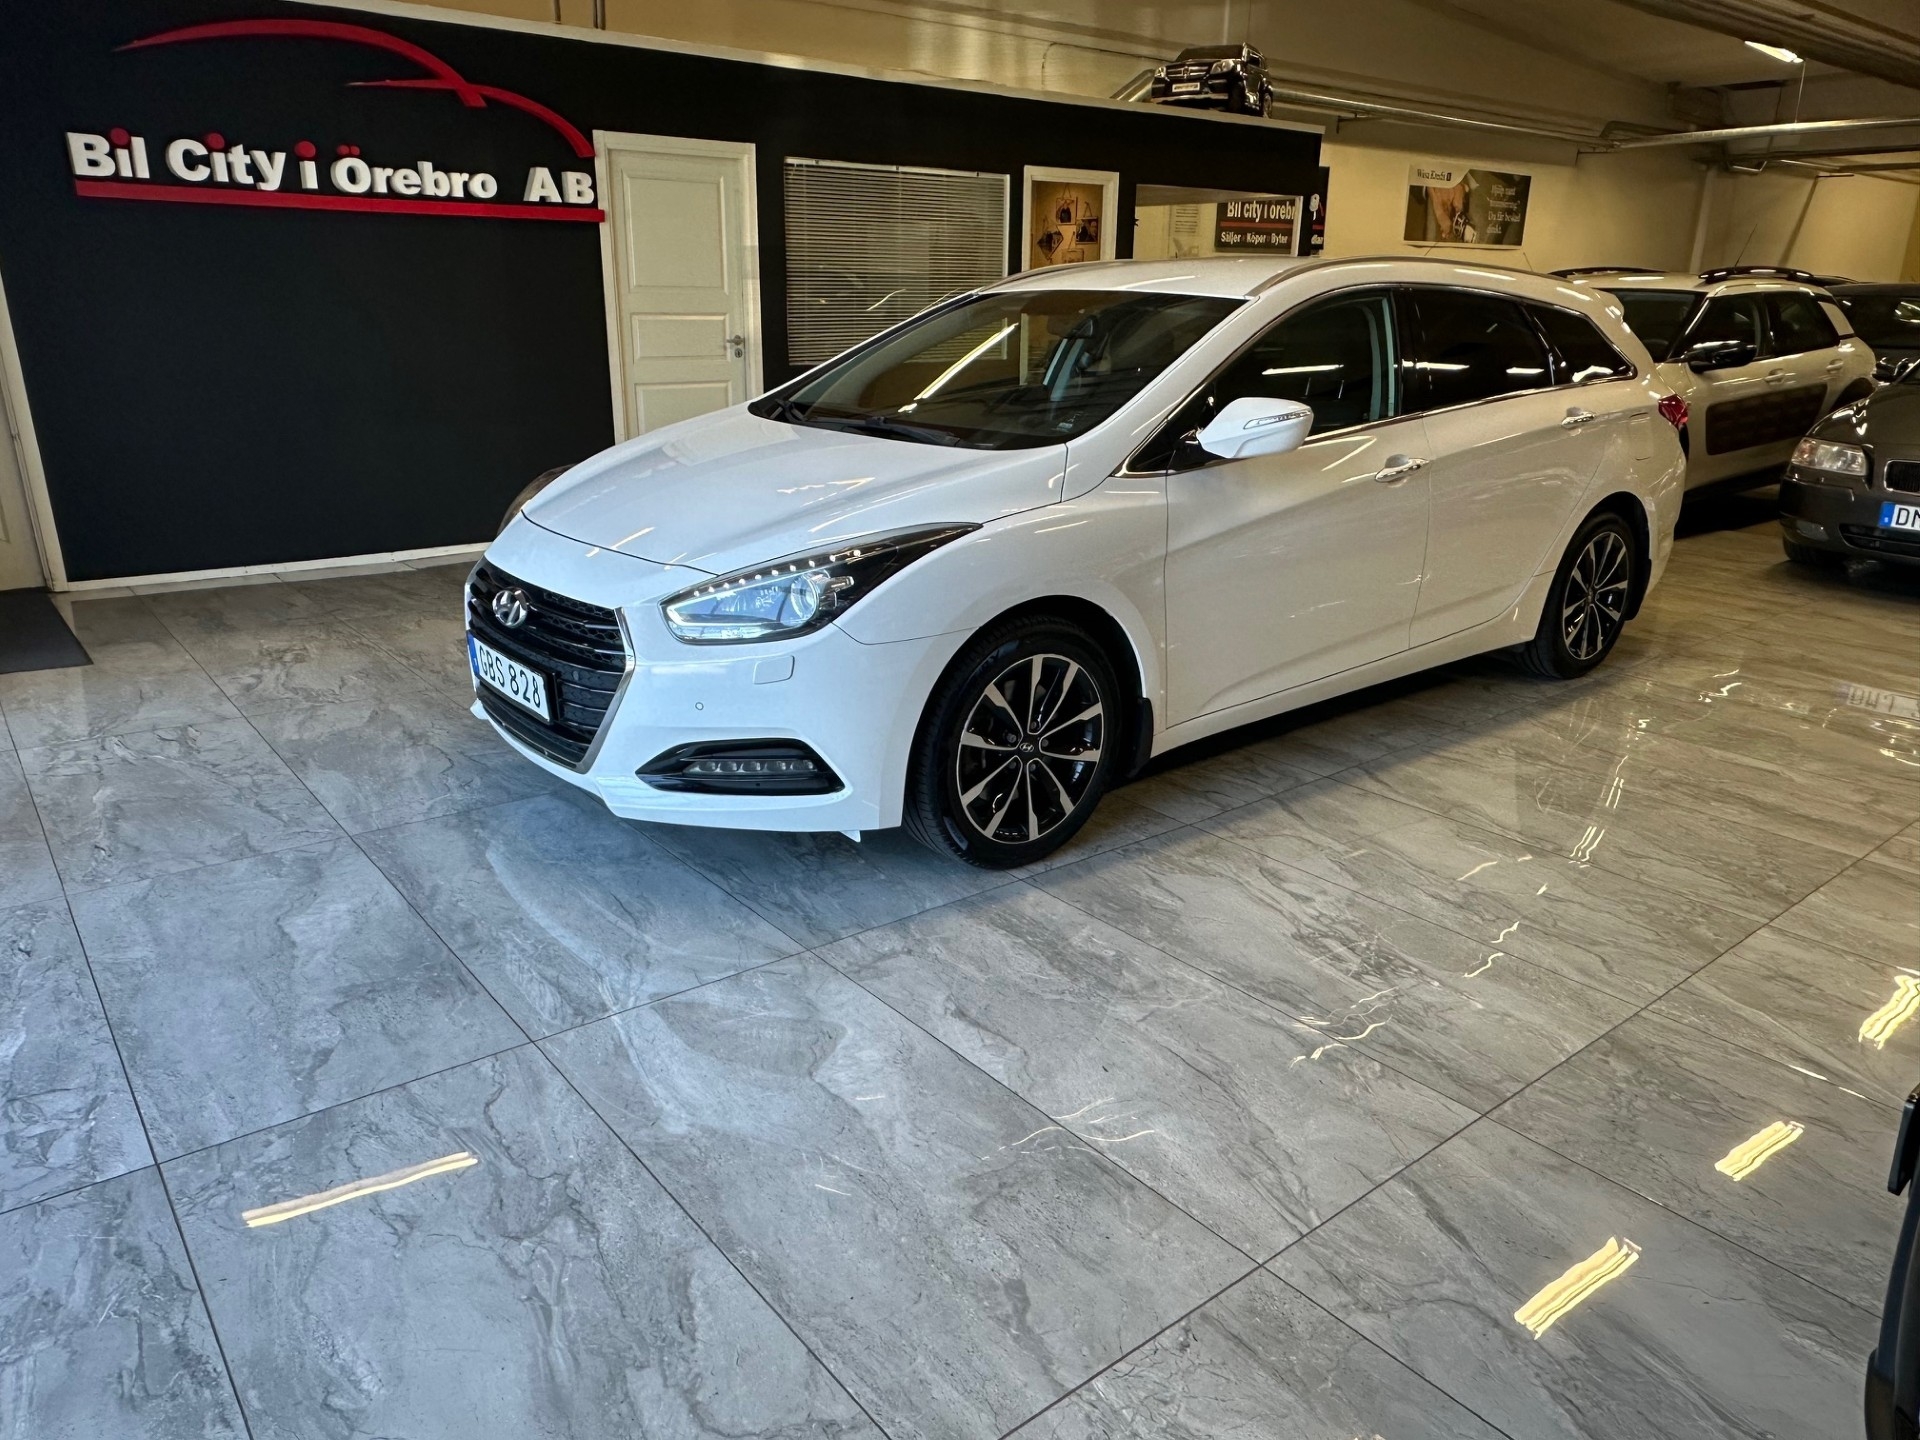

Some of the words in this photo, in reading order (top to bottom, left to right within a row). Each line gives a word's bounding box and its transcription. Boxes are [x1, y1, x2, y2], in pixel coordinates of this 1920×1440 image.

[66, 128, 150, 178] Bil
[166, 132, 286, 191] City
[294, 140, 318, 190] i
[330, 144, 498, 199] Örebro
[523, 166, 595, 204] AB
[1227, 201, 1242, 218] Bil
[1244, 200, 1263, 223] city
[1221, 231, 1242, 245] Säljer
[1246, 232, 1266, 245] Köper
[1271, 233, 1289, 245] Byter
[480, 645, 505, 688] GBS
[508, 663, 541, 708] 828
